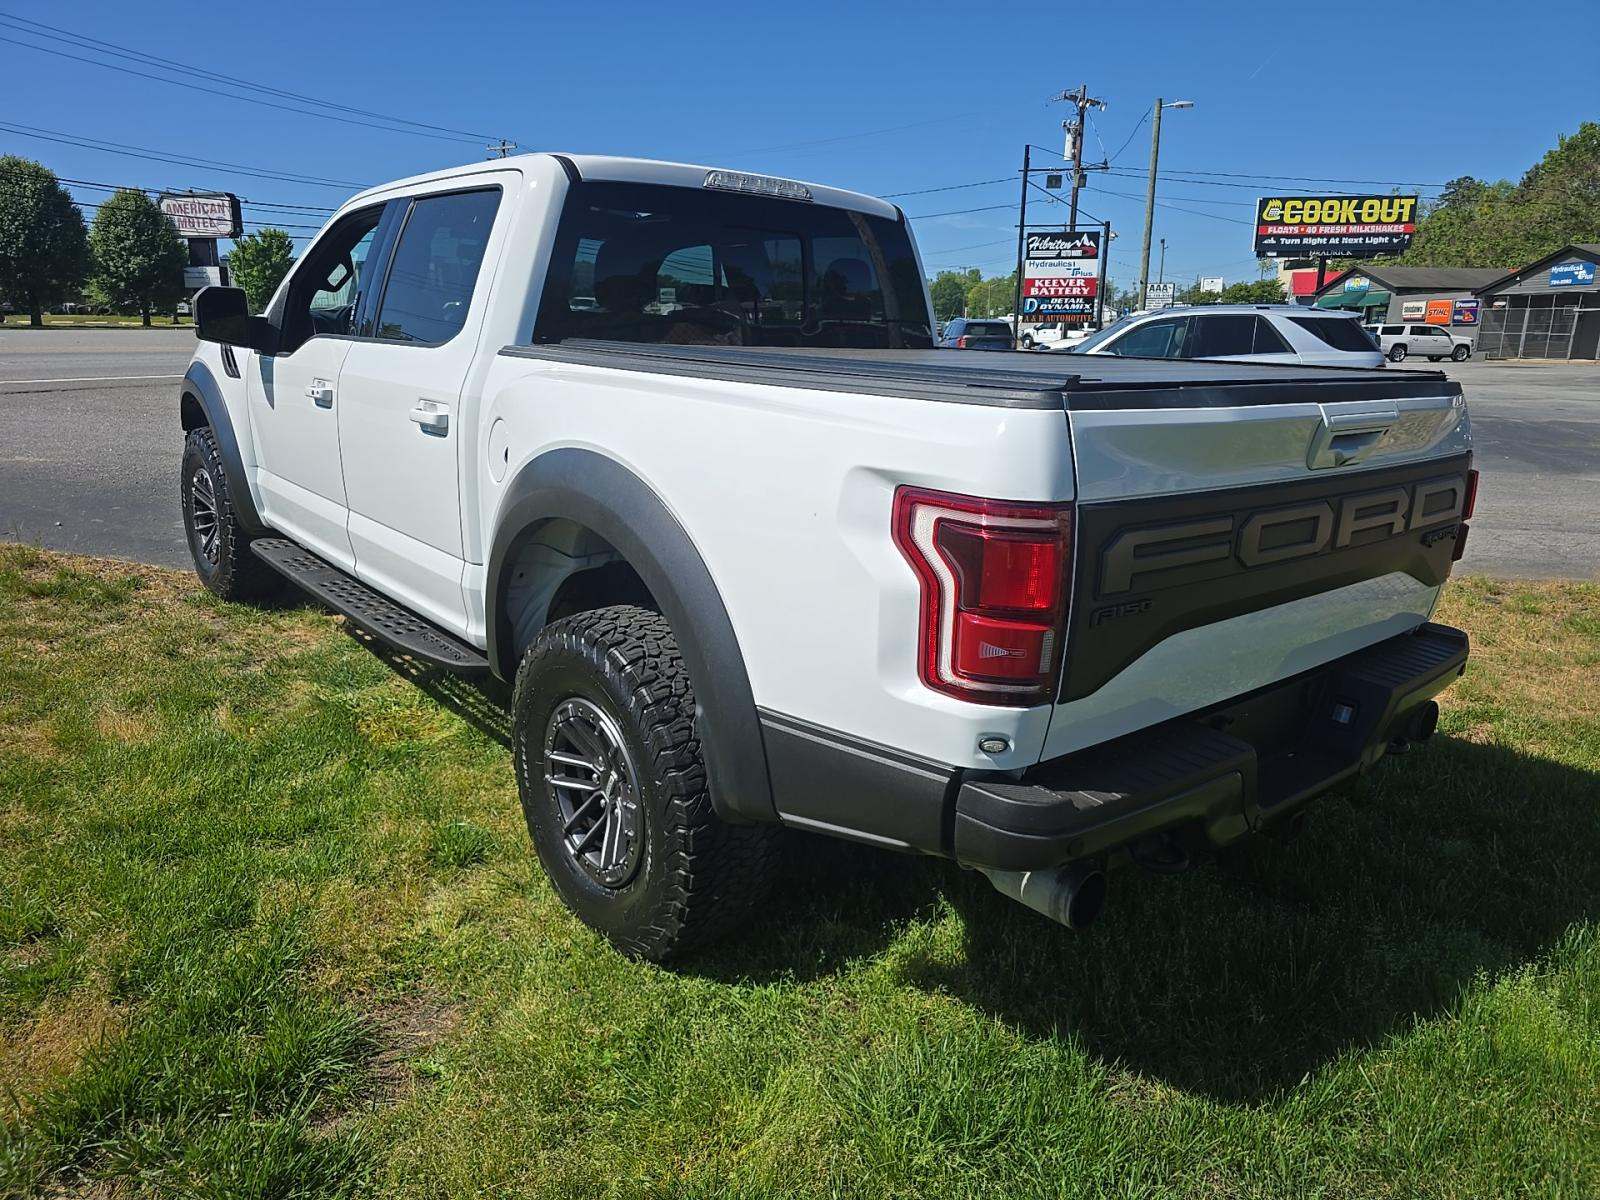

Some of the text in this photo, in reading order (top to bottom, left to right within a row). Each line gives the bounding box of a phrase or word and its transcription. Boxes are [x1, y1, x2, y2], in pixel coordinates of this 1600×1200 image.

[166, 202, 225, 215] AMERICAN
[1284, 198, 1415, 224] COOK OUT
[1268, 226, 1299, 235] FLOATS
[1319, 225, 1347, 234] FRESH
[1349, 224, 1405, 233] MILKSHAKES
[1303, 237, 1327, 245] Right
[1365, 236, 1389, 245] Light
[1029, 261, 1073, 269] Hydraulics
[1035, 279, 1086, 287] KEEVER
[1030, 287, 1090, 296] BATTERY
[1149, 285, 1168, 293] AAA
[1428, 308, 1449, 317] STIHL
[1101, 477, 1466, 595] FORD
